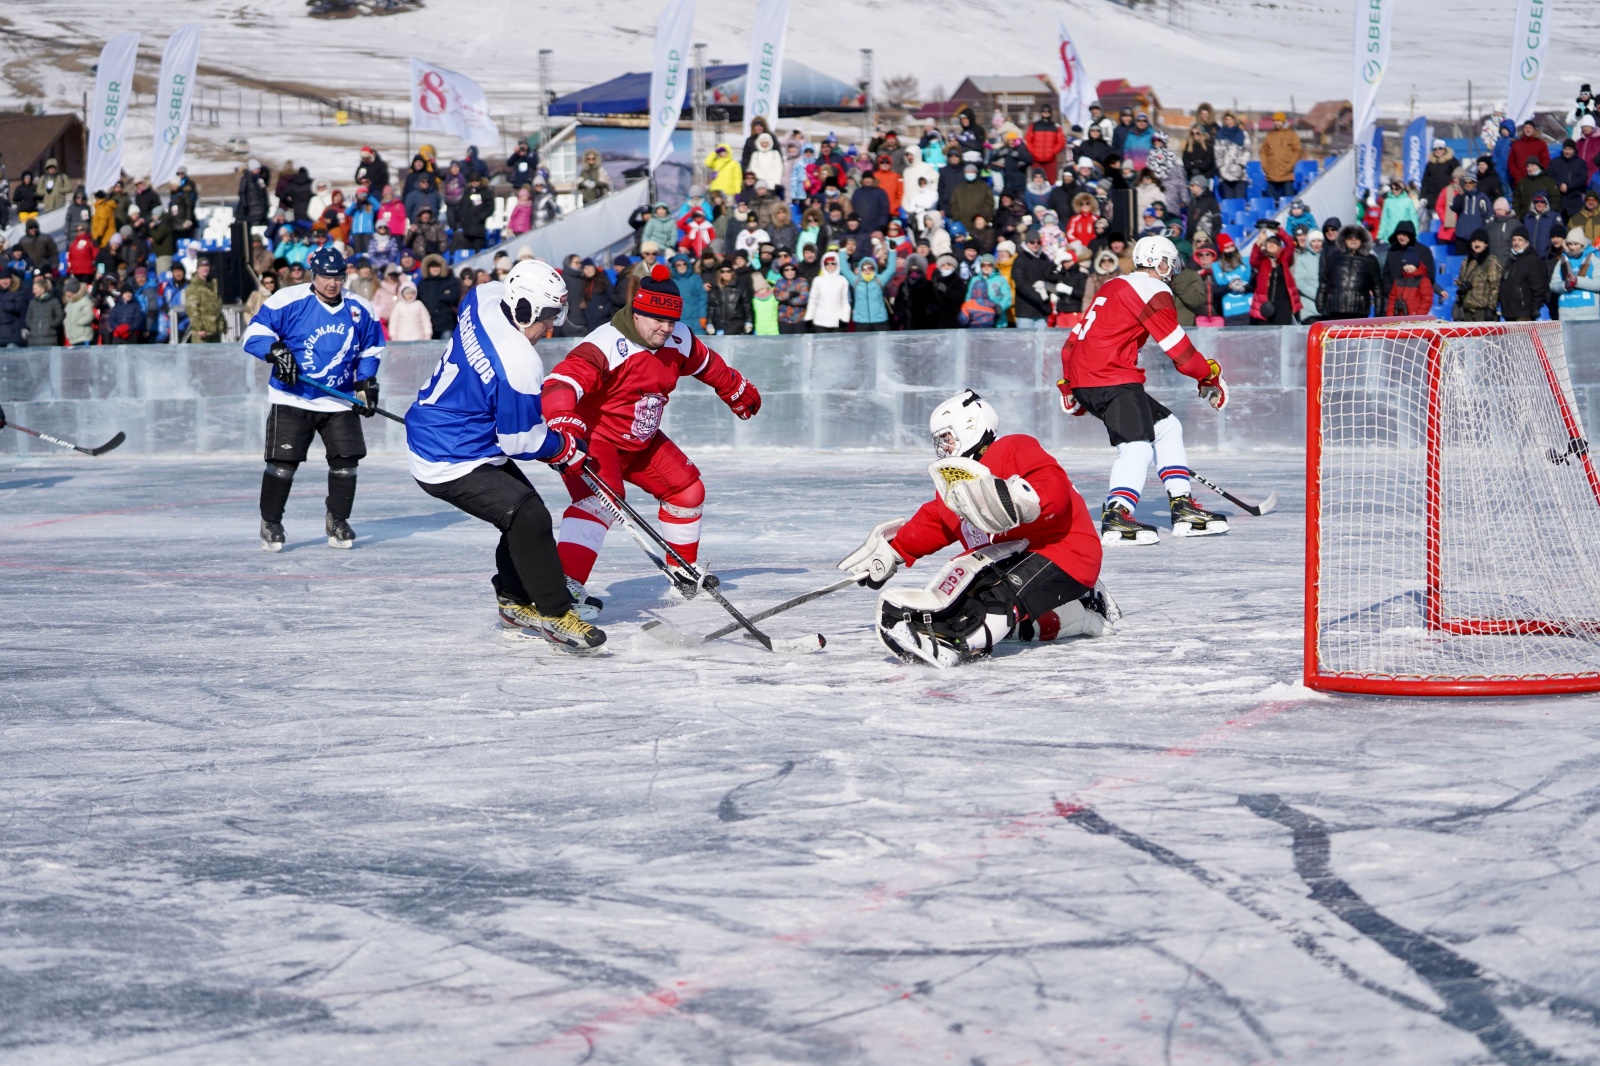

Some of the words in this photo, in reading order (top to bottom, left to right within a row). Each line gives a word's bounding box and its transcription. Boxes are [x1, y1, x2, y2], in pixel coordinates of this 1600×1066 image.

[1366, 0, 1381, 53] SBER
[757, 42, 775, 94] SBER
[104, 81, 121, 127] SBER
[168, 73, 186, 120] SBER
[419, 71, 447, 115] 8
[301, 323, 345, 371] Любимый
[588, 482, 625, 525] WARRIOR
[1194, 474, 1225, 495] CCM
[938, 567, 965, 596] CCM
